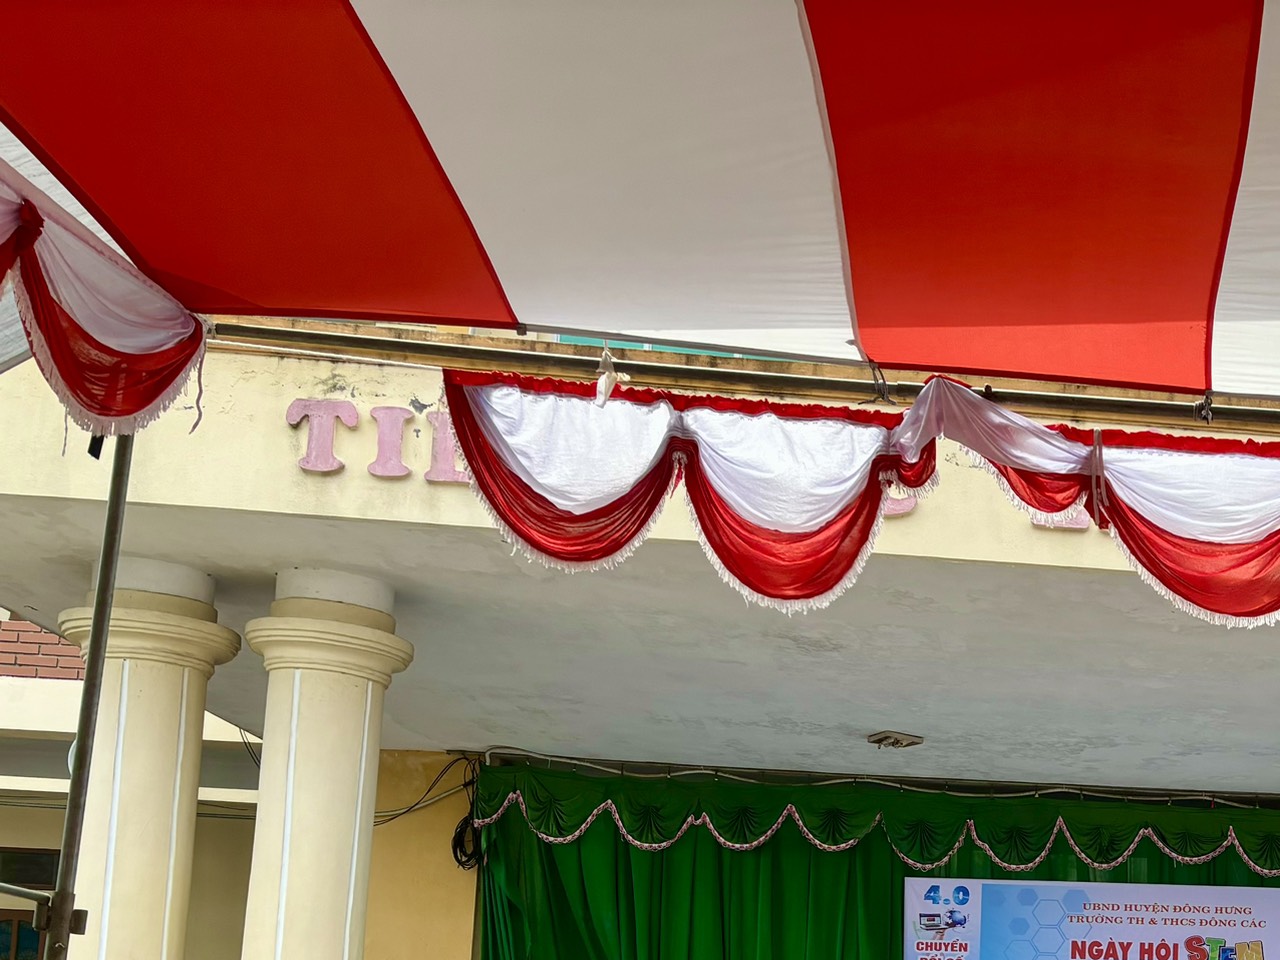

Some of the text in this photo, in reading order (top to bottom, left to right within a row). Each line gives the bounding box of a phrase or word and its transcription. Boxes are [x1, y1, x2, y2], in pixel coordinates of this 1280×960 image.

[924, 884, 970, 906] 4.0
[1082, 902, 1252, 915] UBND HUYỆN ĐÔNG HƯNG
[1067, 913, 1123, 925] TRƯỜNG
[1126, 917, 1145, 925] TH
[1148, 917, 1158, 925] &
[1161, 918, 1196, 926] THCS
[1241, 917, 1267, 928] CÁC
[916, 938, 968, 952] CHUYỂN
[1070, 937, 1133, 960] NGÀY
